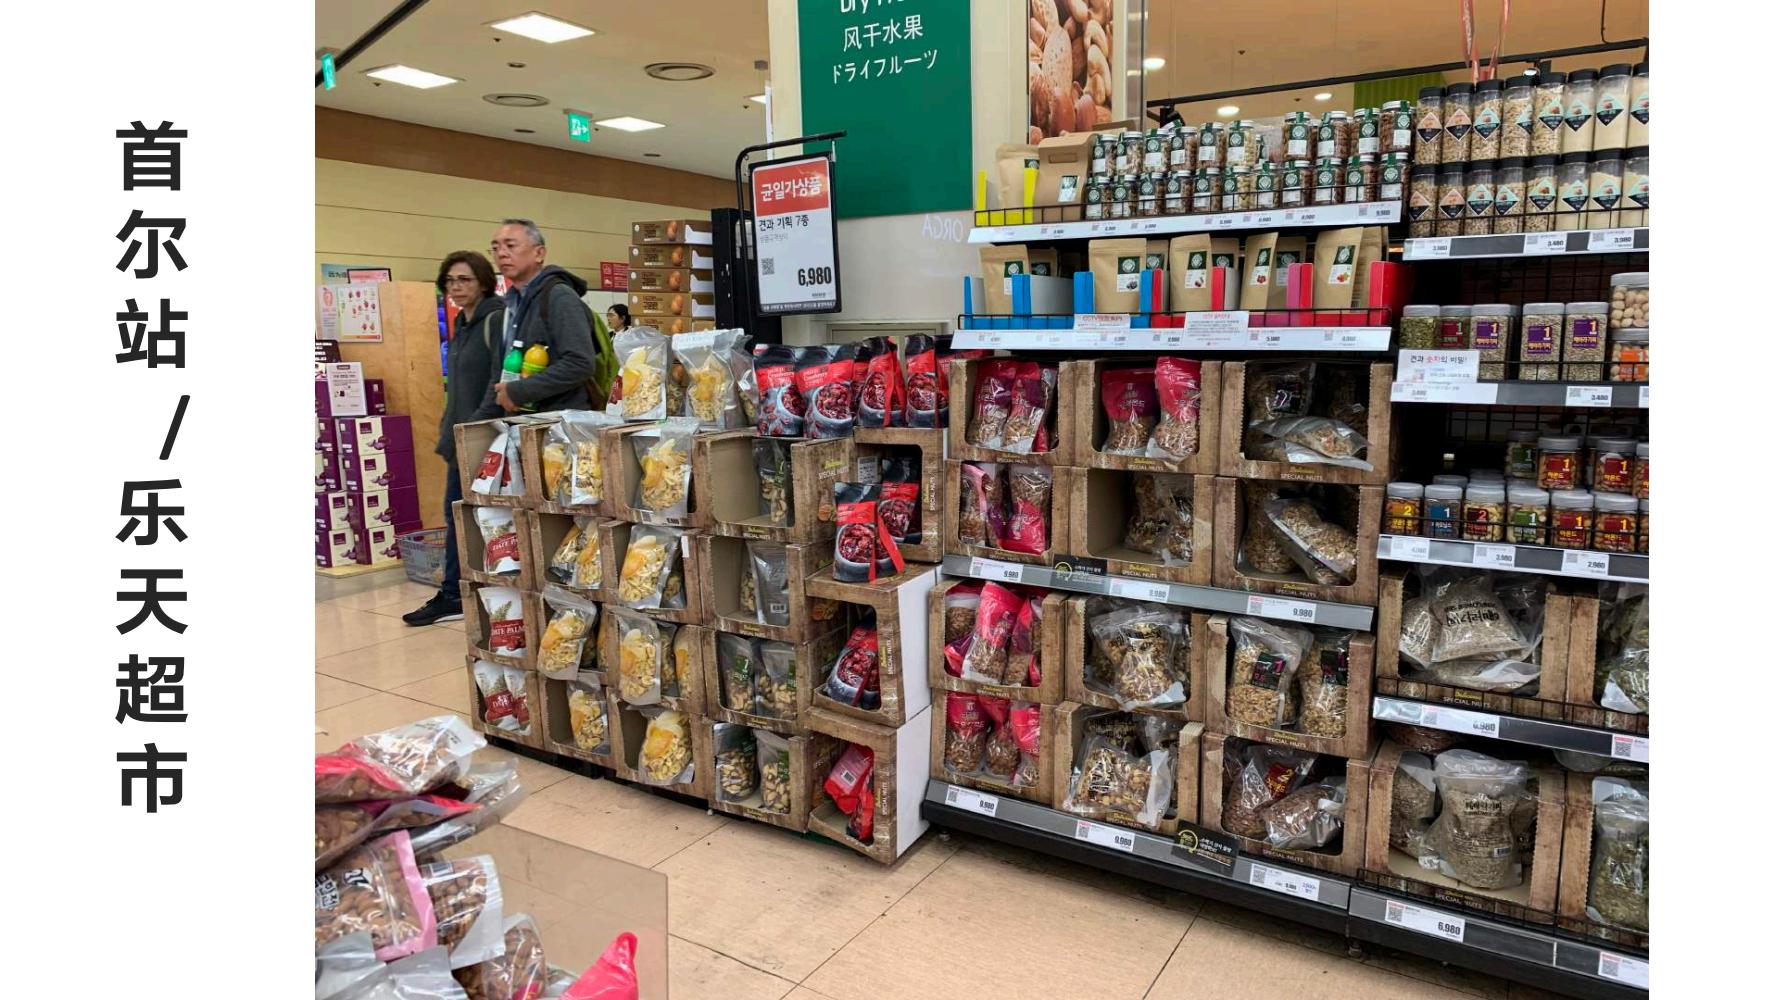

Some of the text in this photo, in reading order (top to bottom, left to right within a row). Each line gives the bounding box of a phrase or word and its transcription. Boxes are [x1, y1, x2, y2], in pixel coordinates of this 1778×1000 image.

[843, 14, 923, 52] 风干水果
[833, 49, 938, 84] ドライフルーツ
[760, 175, 822, 202] 균일가상품
[759, 218, 774, 231] 견과
[798, 266, 832, 287] 6,980
[1563, 458, 1570, 469] 1
[1621, 460, 1627, 471] 1
[1403, 505, 1412, 516] 2
[1443, 507, 1450, 518] 1
[1478, 510, 1486, 520] 2
[1529, 512, 1536, 523] 1
[1575, 516, 1582, 527] 1
[1620, 519, 1627, 531] 1
[1293, 607, 1313, 618] 9,980
[1266, 736, 1307, 748] SPECIAL NUTS
[1438, 921, 1461, 936] 6,980
